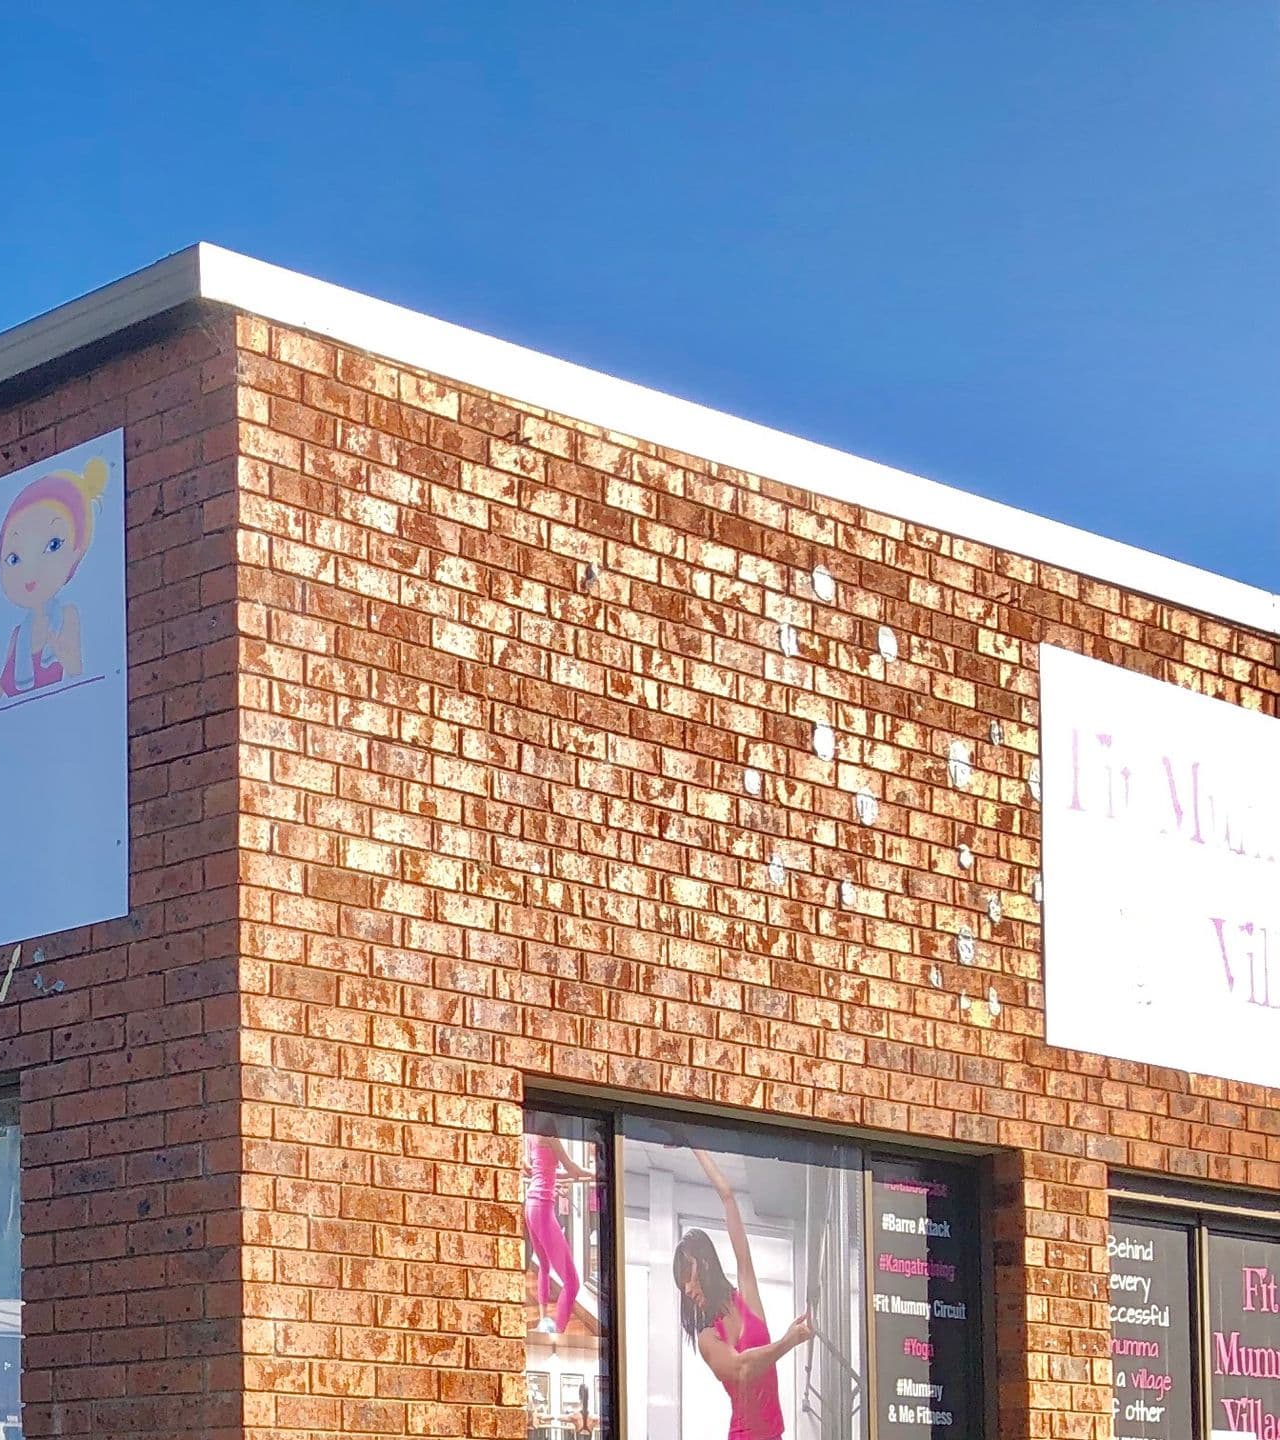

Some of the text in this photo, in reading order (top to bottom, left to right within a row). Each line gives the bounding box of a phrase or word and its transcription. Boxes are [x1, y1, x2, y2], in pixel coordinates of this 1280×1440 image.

[882, 1213, 951, 1238] #Barre Attack
[1106, 1235, 1153, 1261] Behind
[879, 1253, 956, 1282] #Kangatraining
[1110, 1273, 1151, 1303] every
[1242, 1267, 1279, 1313] Fit
[891, 1295, 931, 1320] Mummy
[933, 1300, 967, 1320] Circuit
[1109, 1304, 1169, 1327] ccessful
[904, 1338, 934, 1361] #Yoga
[1213, 1331, 1280, 1379] Mum
[896, 1378, 943, 1402] #Mummy
[1116, 1368, 1172, 1401] a village
[888, 1404, 953, 1426] & Me Fitness
[1125, 1400, 1165, 1422] other
